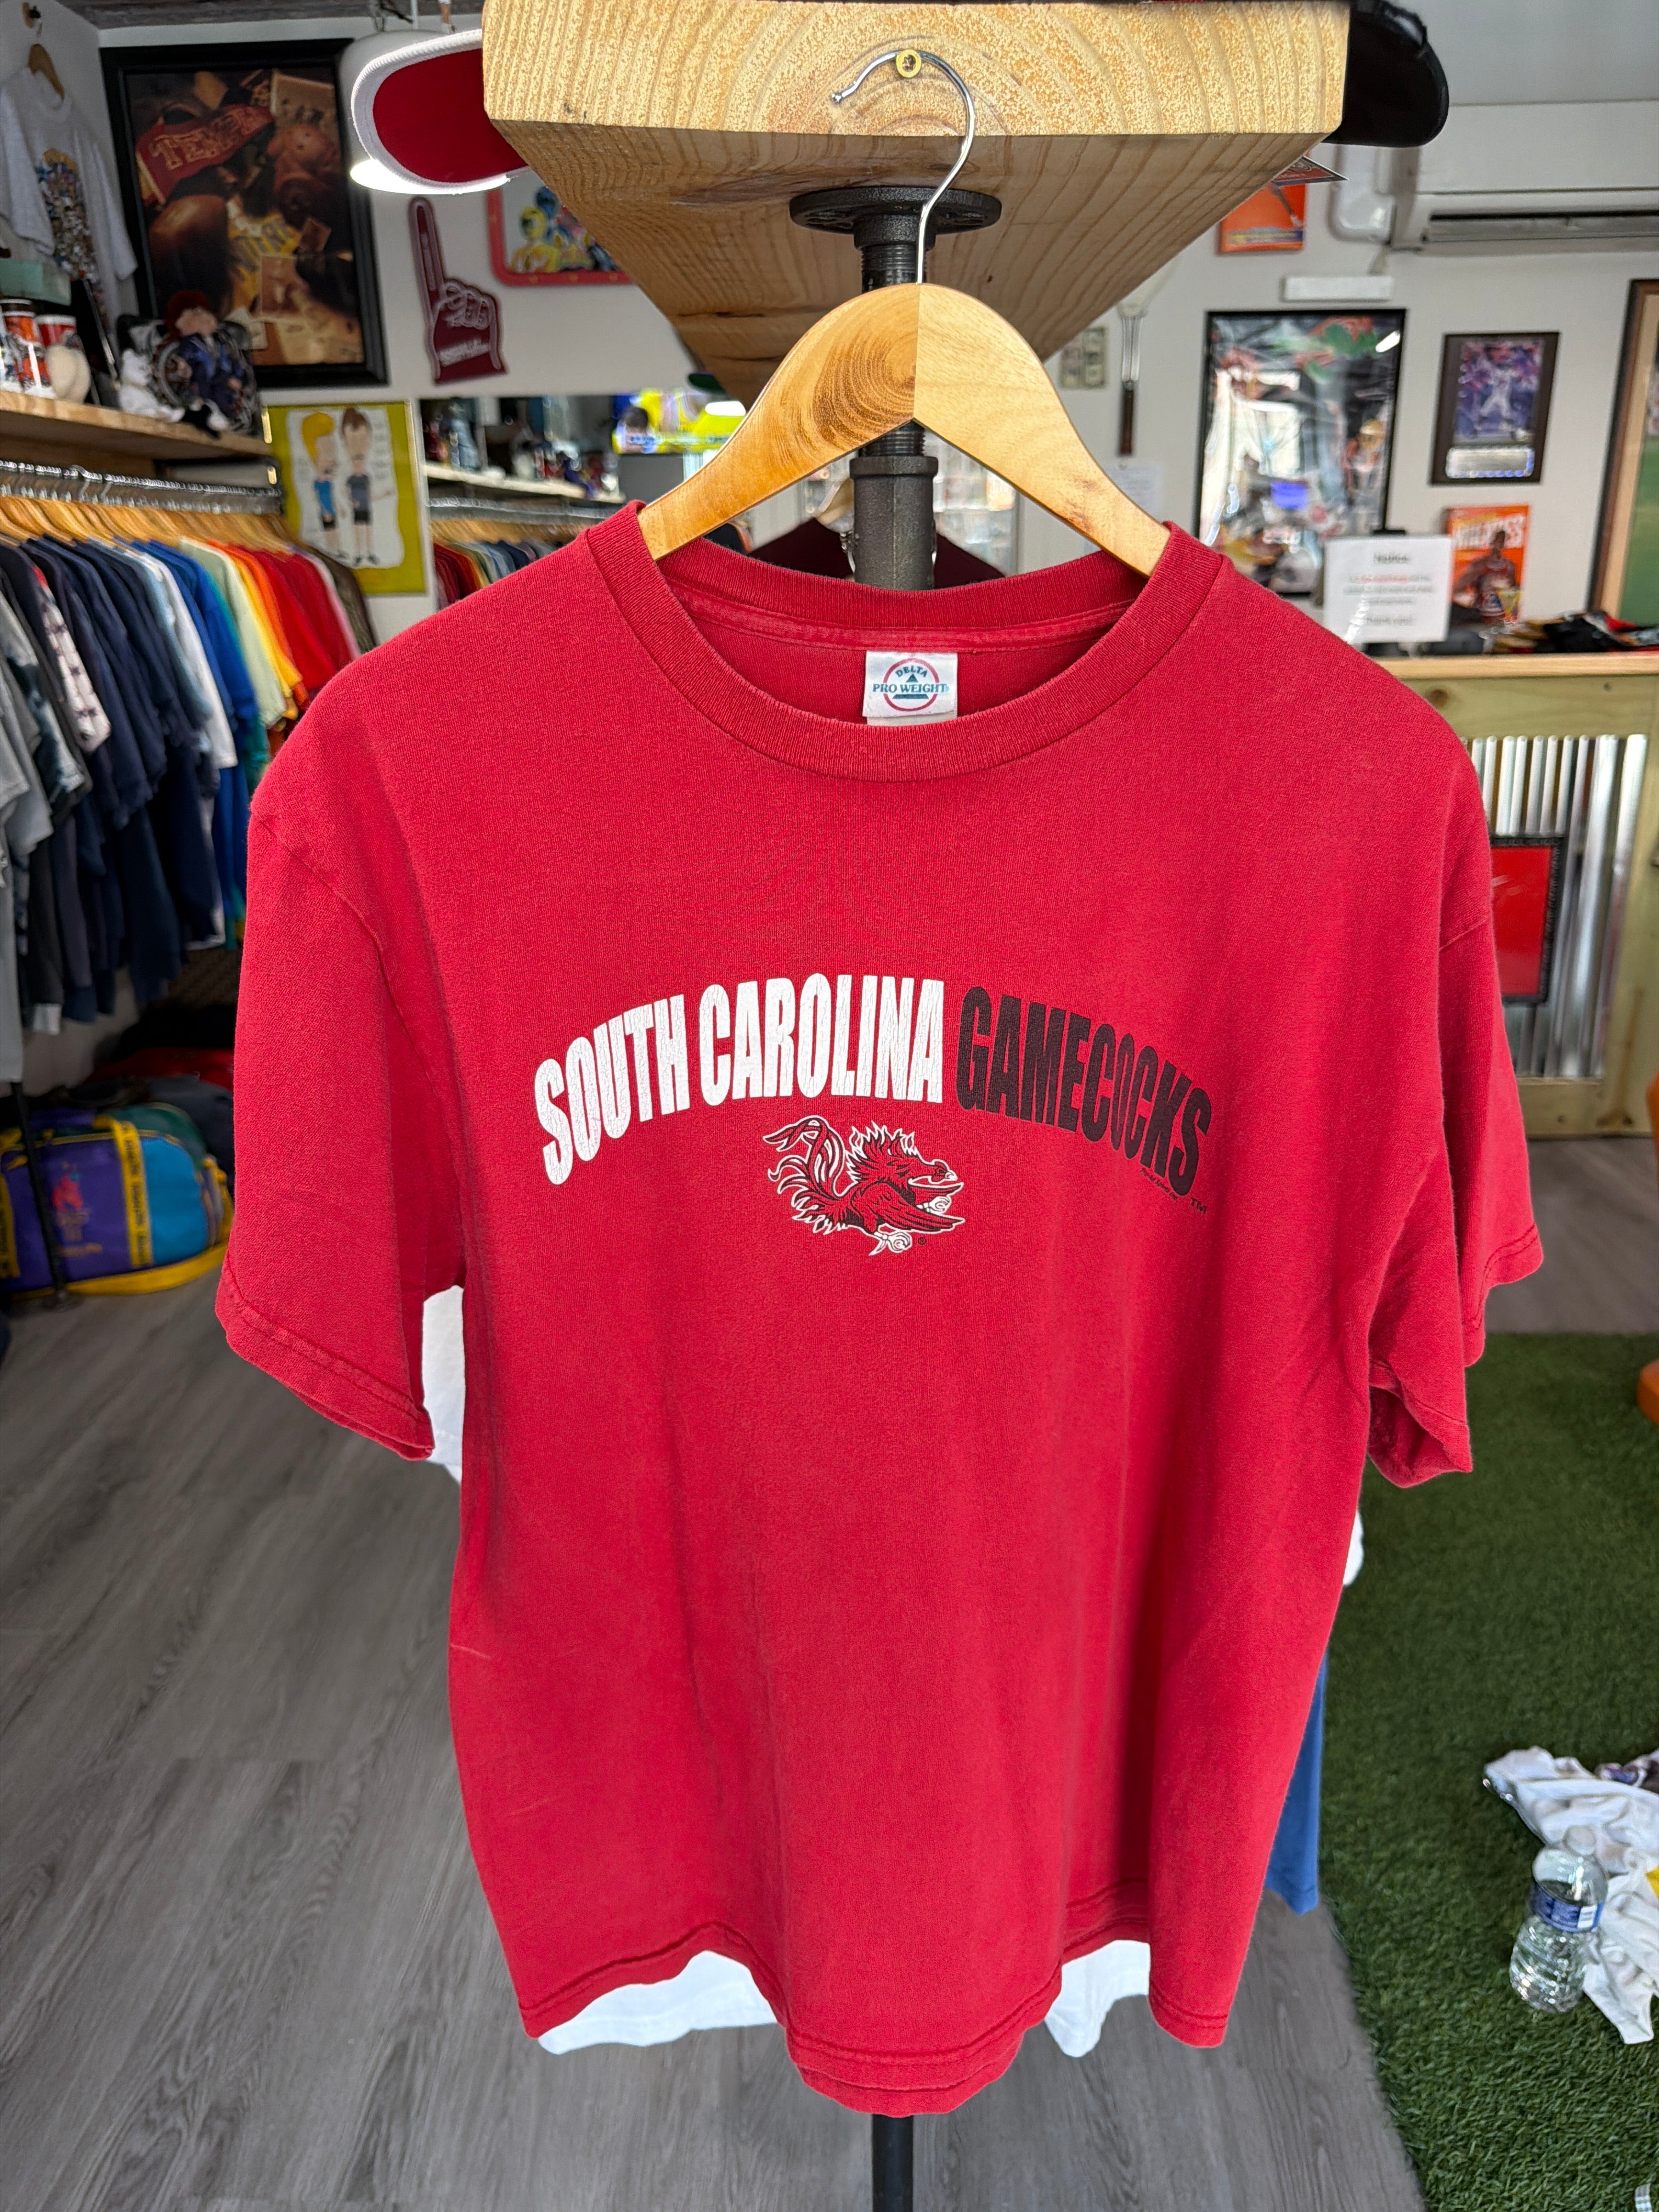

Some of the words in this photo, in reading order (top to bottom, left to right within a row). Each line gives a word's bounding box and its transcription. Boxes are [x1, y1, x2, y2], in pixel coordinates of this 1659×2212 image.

[895, 665, 928, 678] DELTA
[873, 684, 897, 693] PRO
[900, 684, 947, 693] WEIGHT
[534, 994, 691, 1186] SOUTH
[699, 973, 945, 1105] CAROLINA
[956, 986, 1212, 1197] GAMECOCKS
